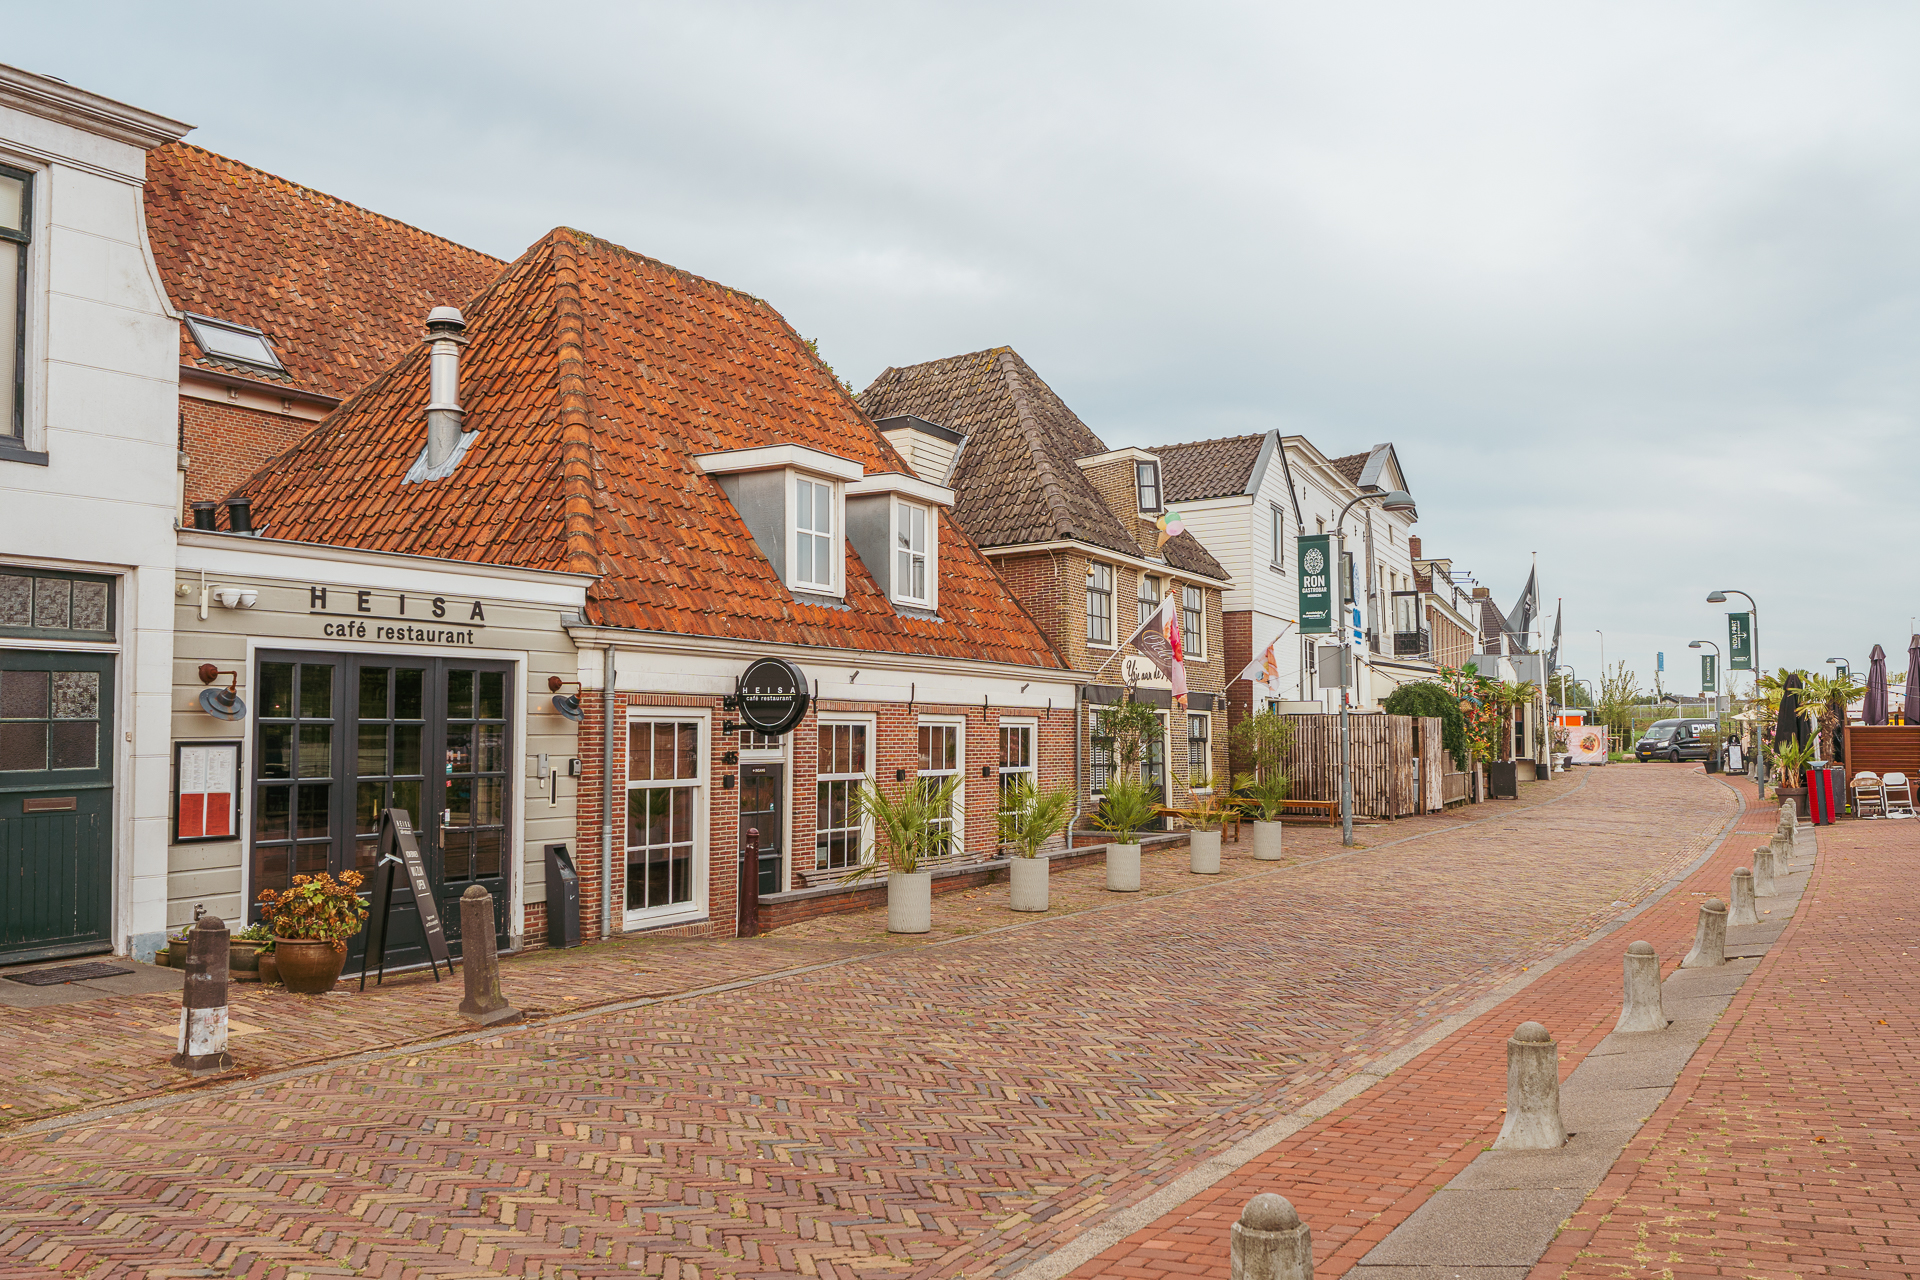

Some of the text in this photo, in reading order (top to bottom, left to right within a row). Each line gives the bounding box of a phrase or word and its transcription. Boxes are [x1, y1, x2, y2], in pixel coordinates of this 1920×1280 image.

[1303, 575, 1325, 587] RON
[310, 586, 485, 621] HEISA
[324, 621, 474, 644] café restaurant
[1141, 672, 1152, 680] aan
[742, 686, 796, 694] HEISA
